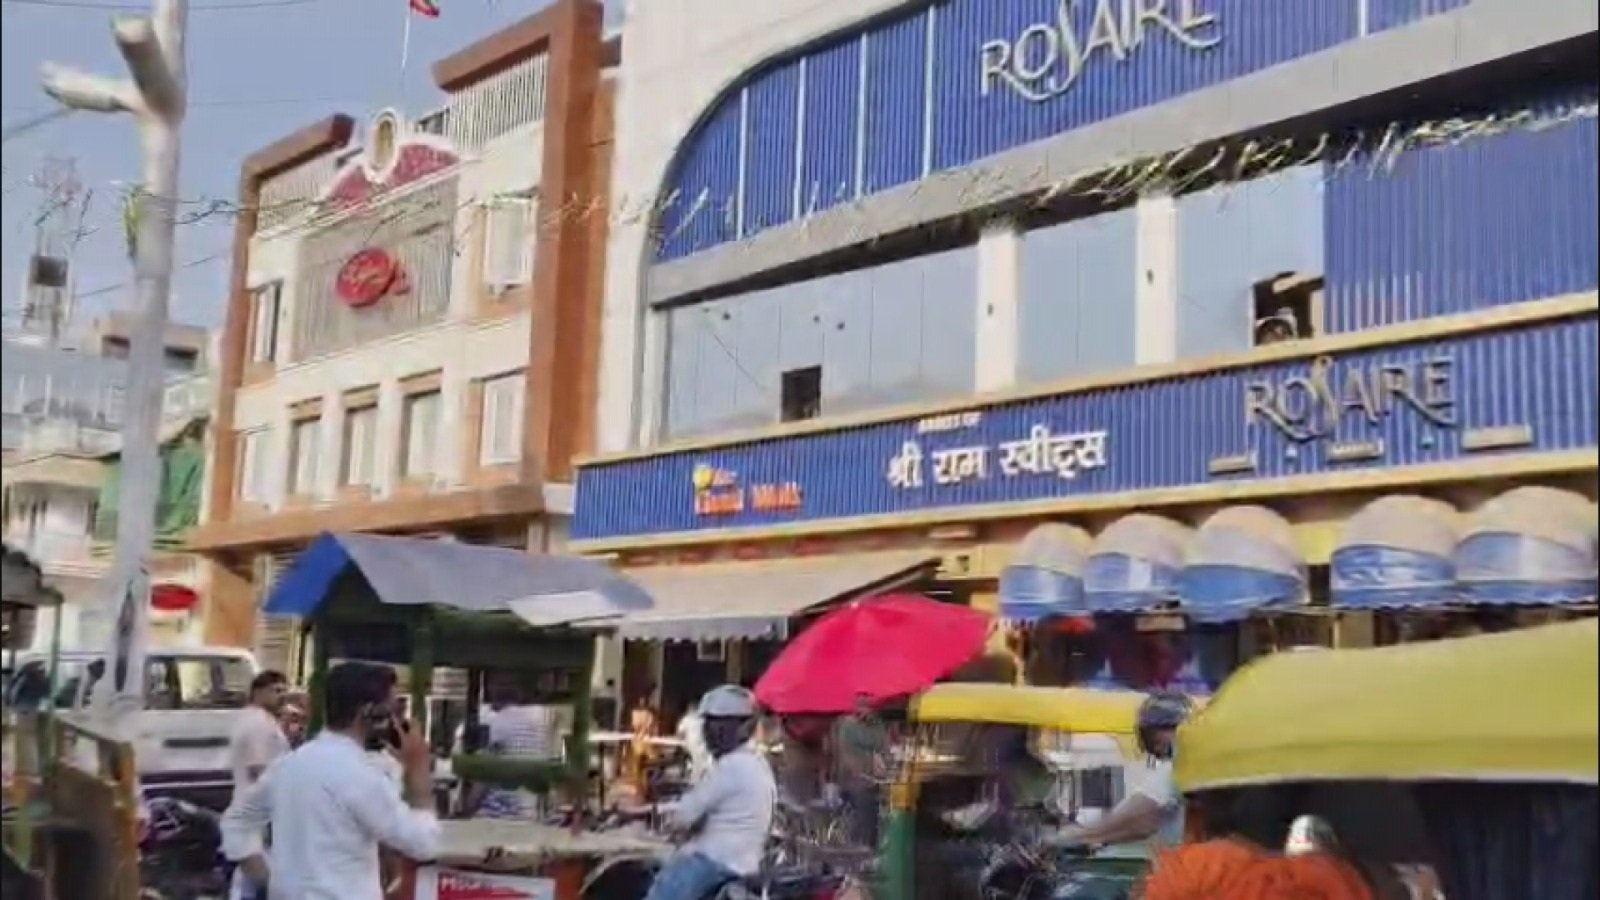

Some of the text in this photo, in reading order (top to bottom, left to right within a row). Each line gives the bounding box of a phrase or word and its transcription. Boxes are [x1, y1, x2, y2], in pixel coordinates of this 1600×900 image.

[1246, 355, 1456, 441] ROSAIRE
[887, 440, 923, 488] श्री
[931, 446, 986, 483] राम
